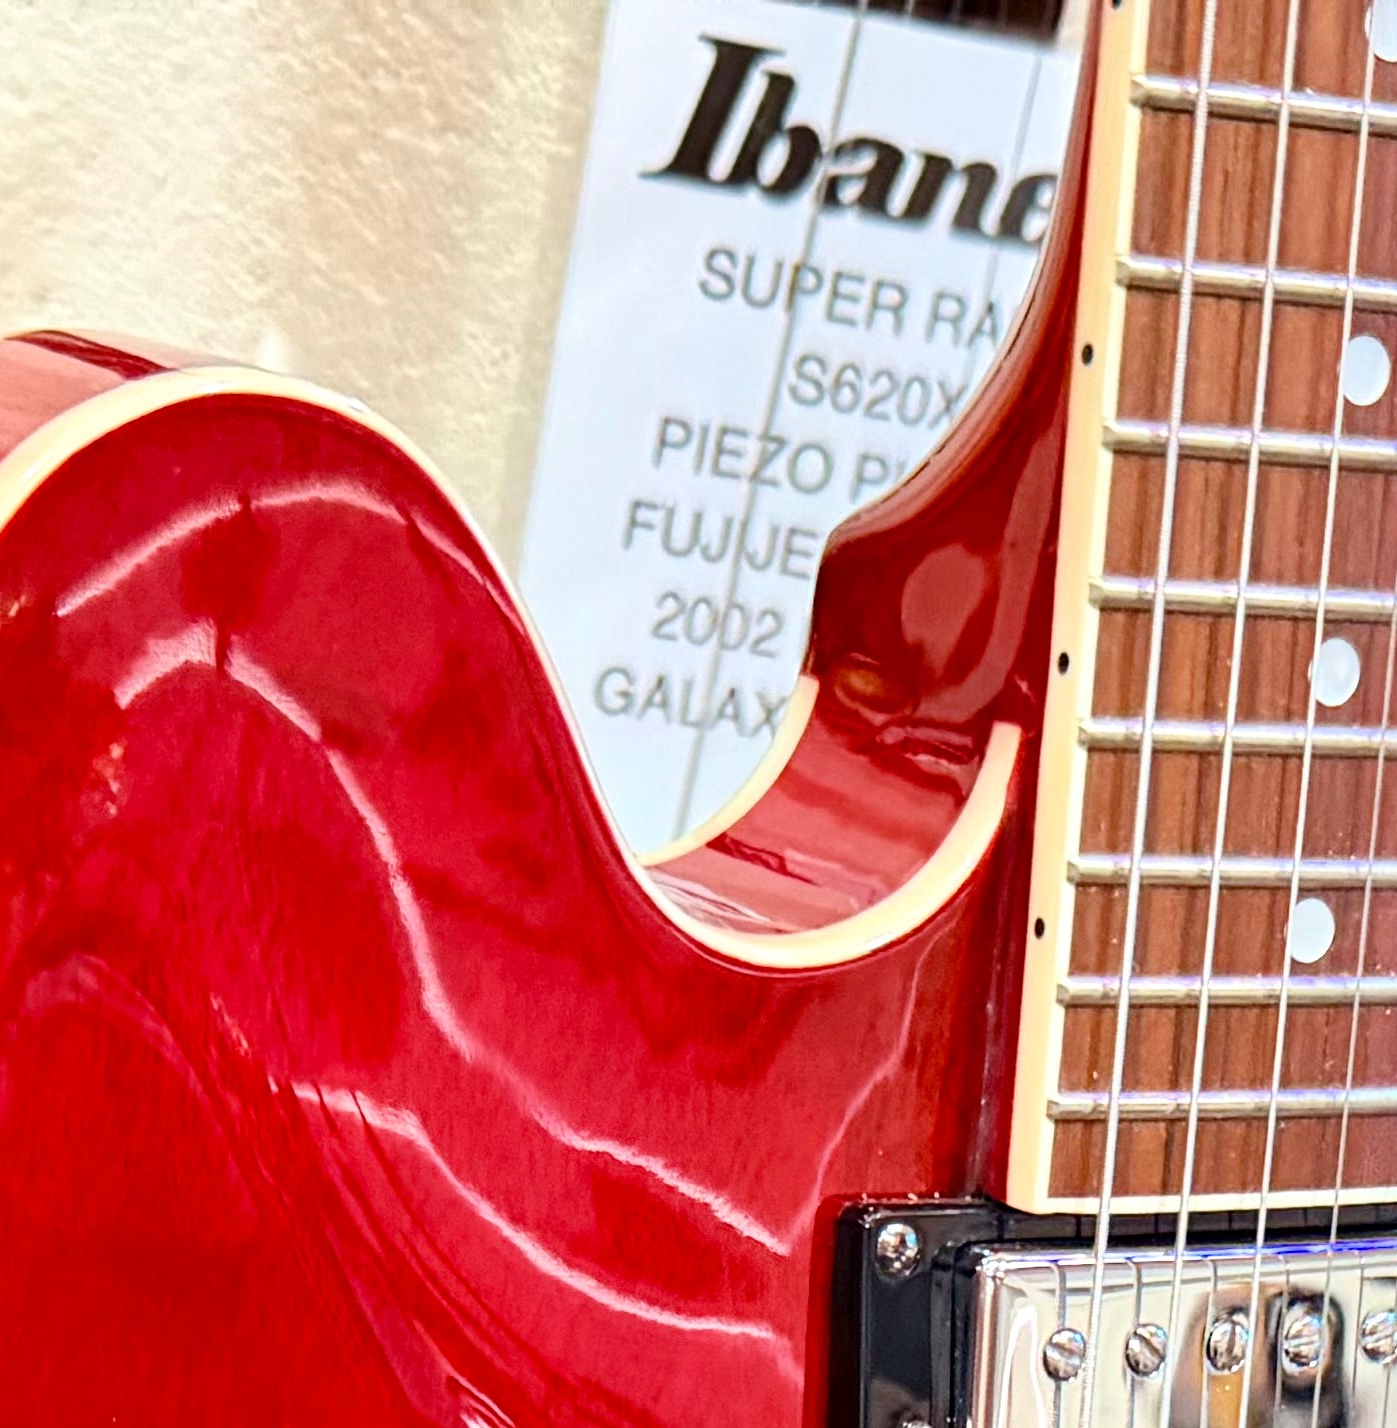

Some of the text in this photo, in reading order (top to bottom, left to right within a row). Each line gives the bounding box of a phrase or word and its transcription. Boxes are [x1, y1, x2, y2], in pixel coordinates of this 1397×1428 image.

[699, 247, 999, 349] SUPER RA
[788, 353, 968, 431] S620X
[651, 416, 907, 503] PIEZO P
[652, 591, 784, 659] 2002
[594, 665, 788, 740] GALAX
